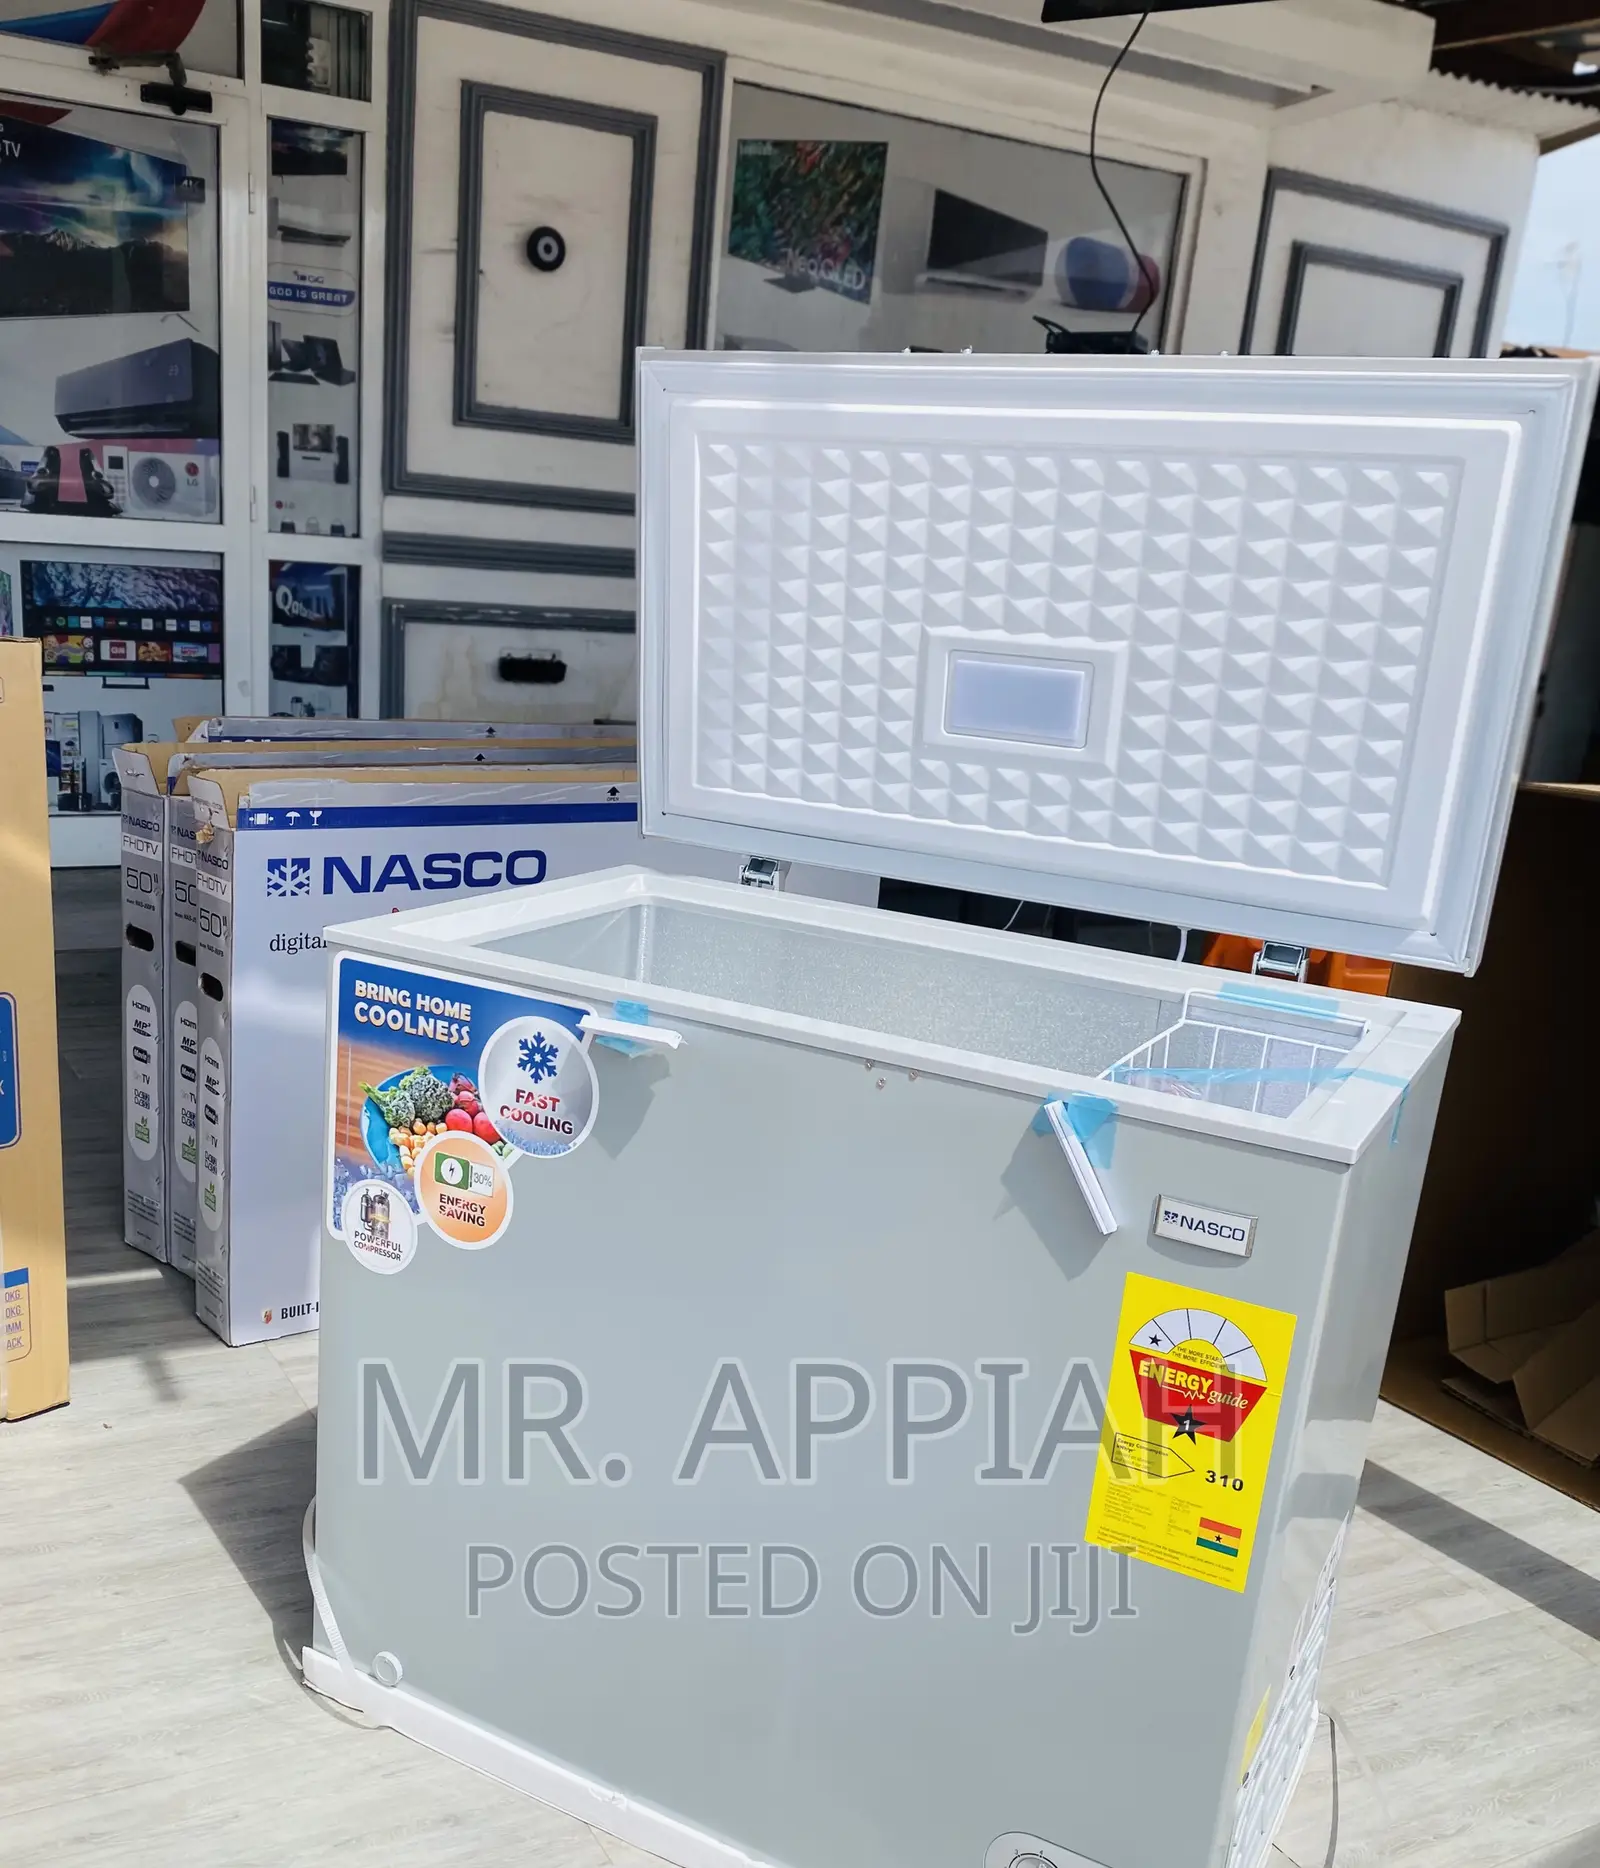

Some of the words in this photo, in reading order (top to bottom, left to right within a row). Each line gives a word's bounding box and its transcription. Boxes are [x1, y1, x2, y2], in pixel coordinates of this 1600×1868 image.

[269, 286, 293, 297] GOD
[296, 289, 307, 299] IS
[311, 291, 348, 303] GREAT
[187, 479, 199, 487] LG
[128, 815, 160, 833] NASCO
[176, 827, 197, 841] NAS
[123, 835, 159, 856] FHDTV
[171, 847, 197, 864] FHDT
[201, 851, 229, 871] NASCO
[196, 872, 228, 895] FHDTV
[322, 850, 547, 895] NASCO
[174, 879, 197, 907] 50
[354, 979, 412, 1009] BRING
[416, 993, 472, 1022] HOME
[354, 1001, 471, 1047] COOLNESS
[515, 1088, 561, 1112] FAST
[500, 1105, 573, 1135] COOLING
[473, 1172, 493, 1188] 30%
[439, 1193, 486, 1215] ENERGY
[438, 1204, 486, 1227] SAVING
[1180, 1215, 1246, 1242] NASCO
[353, 1240, 402, 1262] COMPRESSOR
[354, 1230, 403, 1254] POWERFUL
[280, 1301, 319, 1320] BUILT-I
[1188, 1349, 1204, 1359] MORE
[1138, 1357, 1214, 1394] ENERGY
[1206, 1390, 1249, 1410] guide
[1183, 1419, 1190, 1431] 1
[1204, 1469, 1244, 1492] 310
